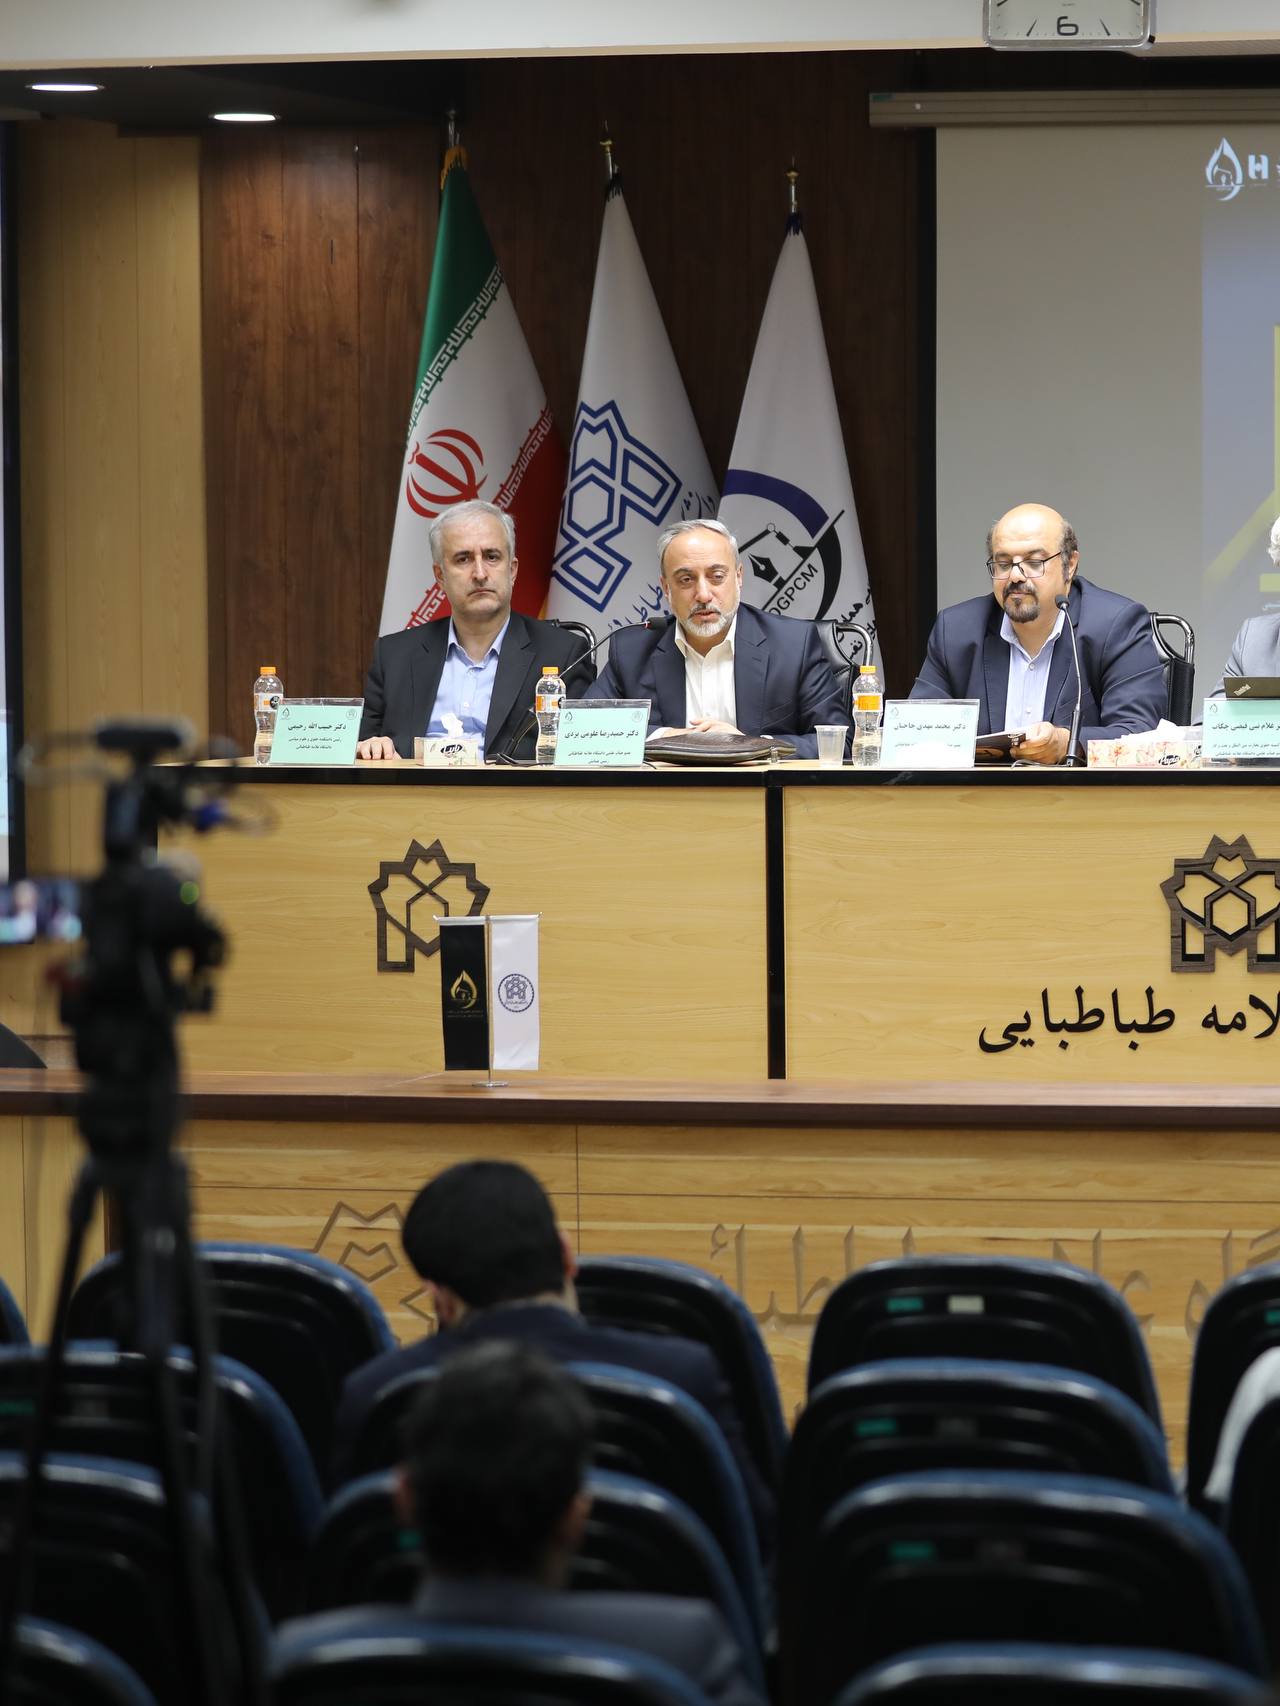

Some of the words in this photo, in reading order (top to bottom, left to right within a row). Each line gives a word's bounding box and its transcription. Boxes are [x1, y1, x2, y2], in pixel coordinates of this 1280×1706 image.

[1057, 16, 1079, 36] 6
[334, 723, 346, 731] دکتر
[953, 723, 966, 731] دکتر
[626, 730, 638, 738] دکتر
[979, 984, 1176, 1053] طباطبایی
